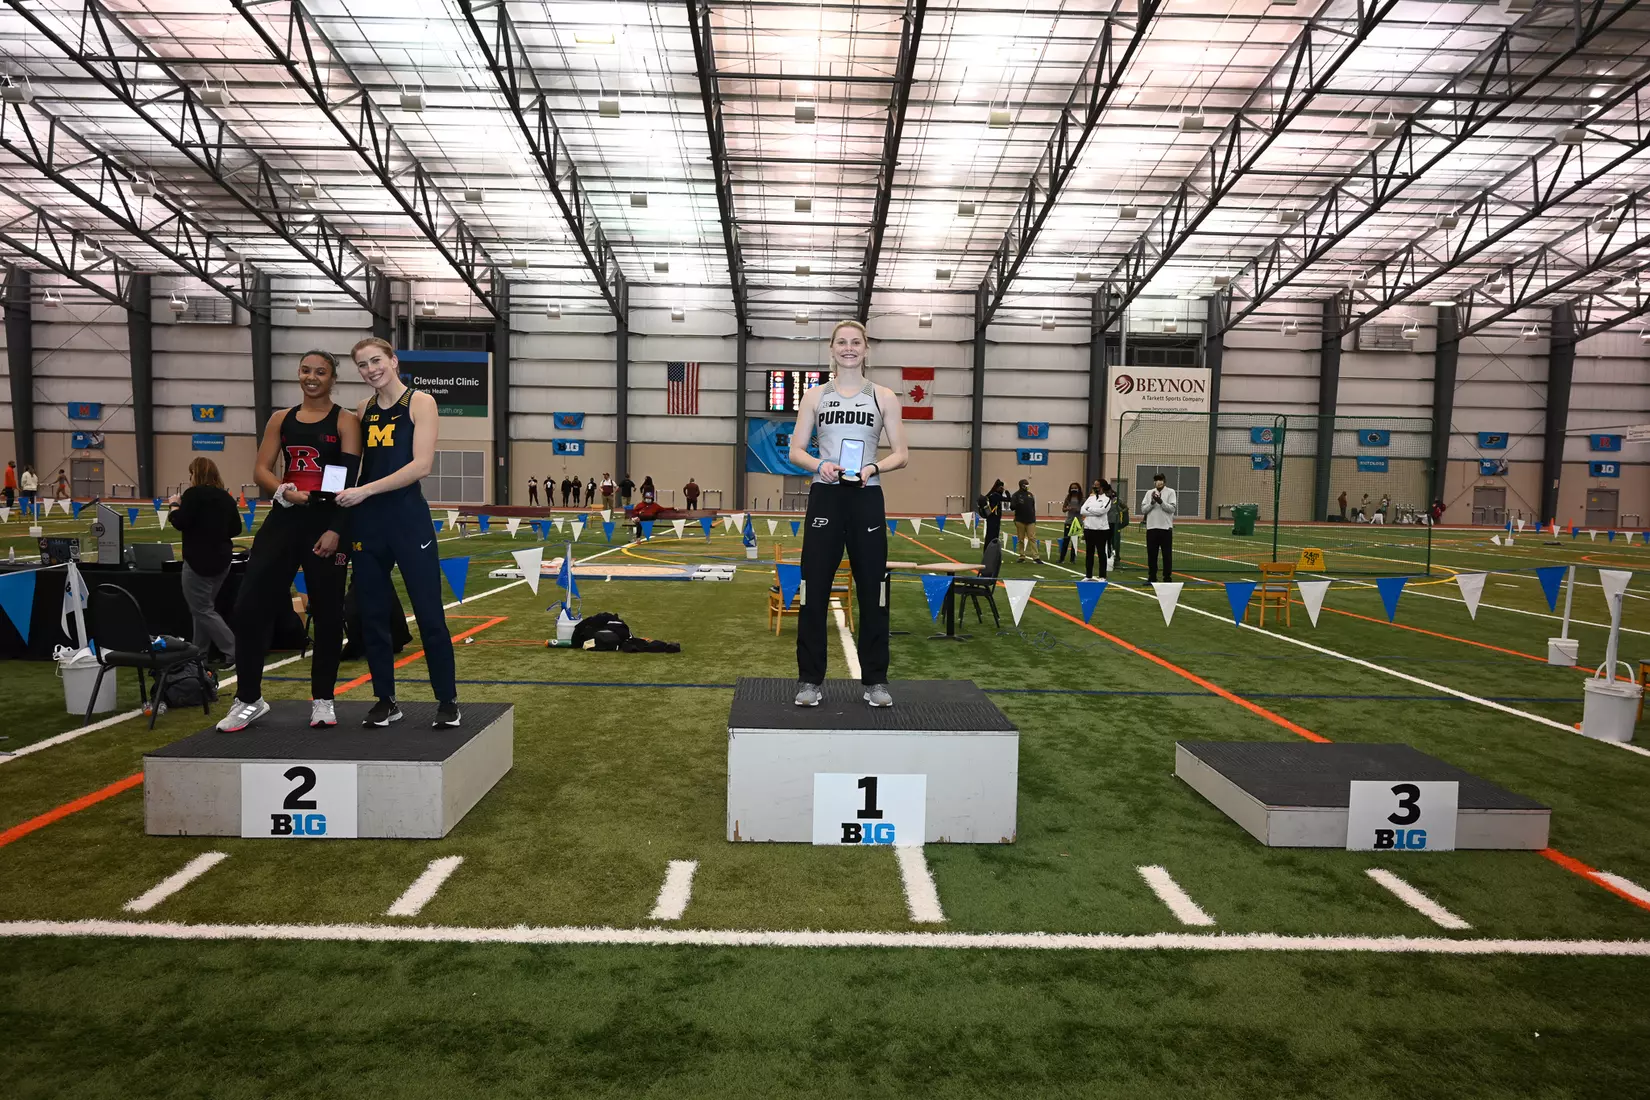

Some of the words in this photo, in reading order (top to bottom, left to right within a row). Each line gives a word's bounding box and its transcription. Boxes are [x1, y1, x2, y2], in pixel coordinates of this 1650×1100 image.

[414, 376, 454, 386] Cleveland
[456, 378, 480, 386] Clinic
[1136, 378, 1205, 393] BEYNON
[200, 408, 214, 418] M
[818, 410, 874, 428] PURDUE
[367, 424, 396, 448] M
[1028, 424, 1039, 436] N
[1600, 438, 1611, 448] R
[286, 446, 322, 472] R
[812, 518, 829, 528] P
[335, 553, 346, 565] R
[283, 766, 317, 810] 2
[857, 776, 883, 819] 1
[1387, 784, 1420, 825] 3
